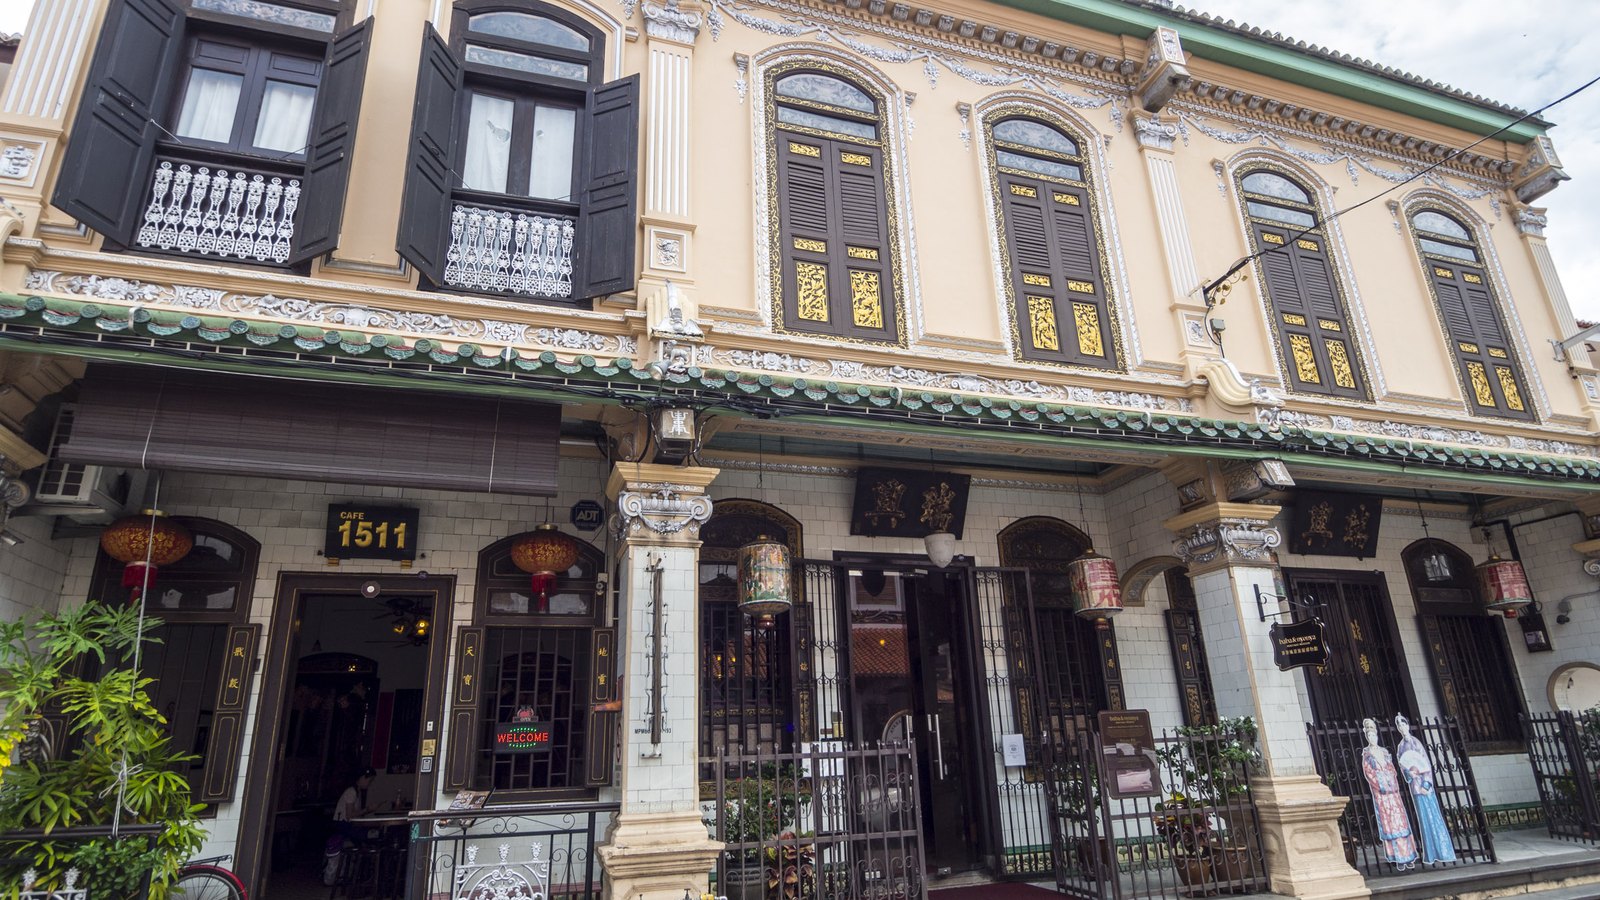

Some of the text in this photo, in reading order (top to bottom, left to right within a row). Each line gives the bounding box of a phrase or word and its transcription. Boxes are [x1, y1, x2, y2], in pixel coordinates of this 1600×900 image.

[340, 511, 365, 520] CAFE
[576, 510, 600, 521] ADT
[338, 520, 407, 549] 1511
[497, 732, 549, 743] WELCOME
